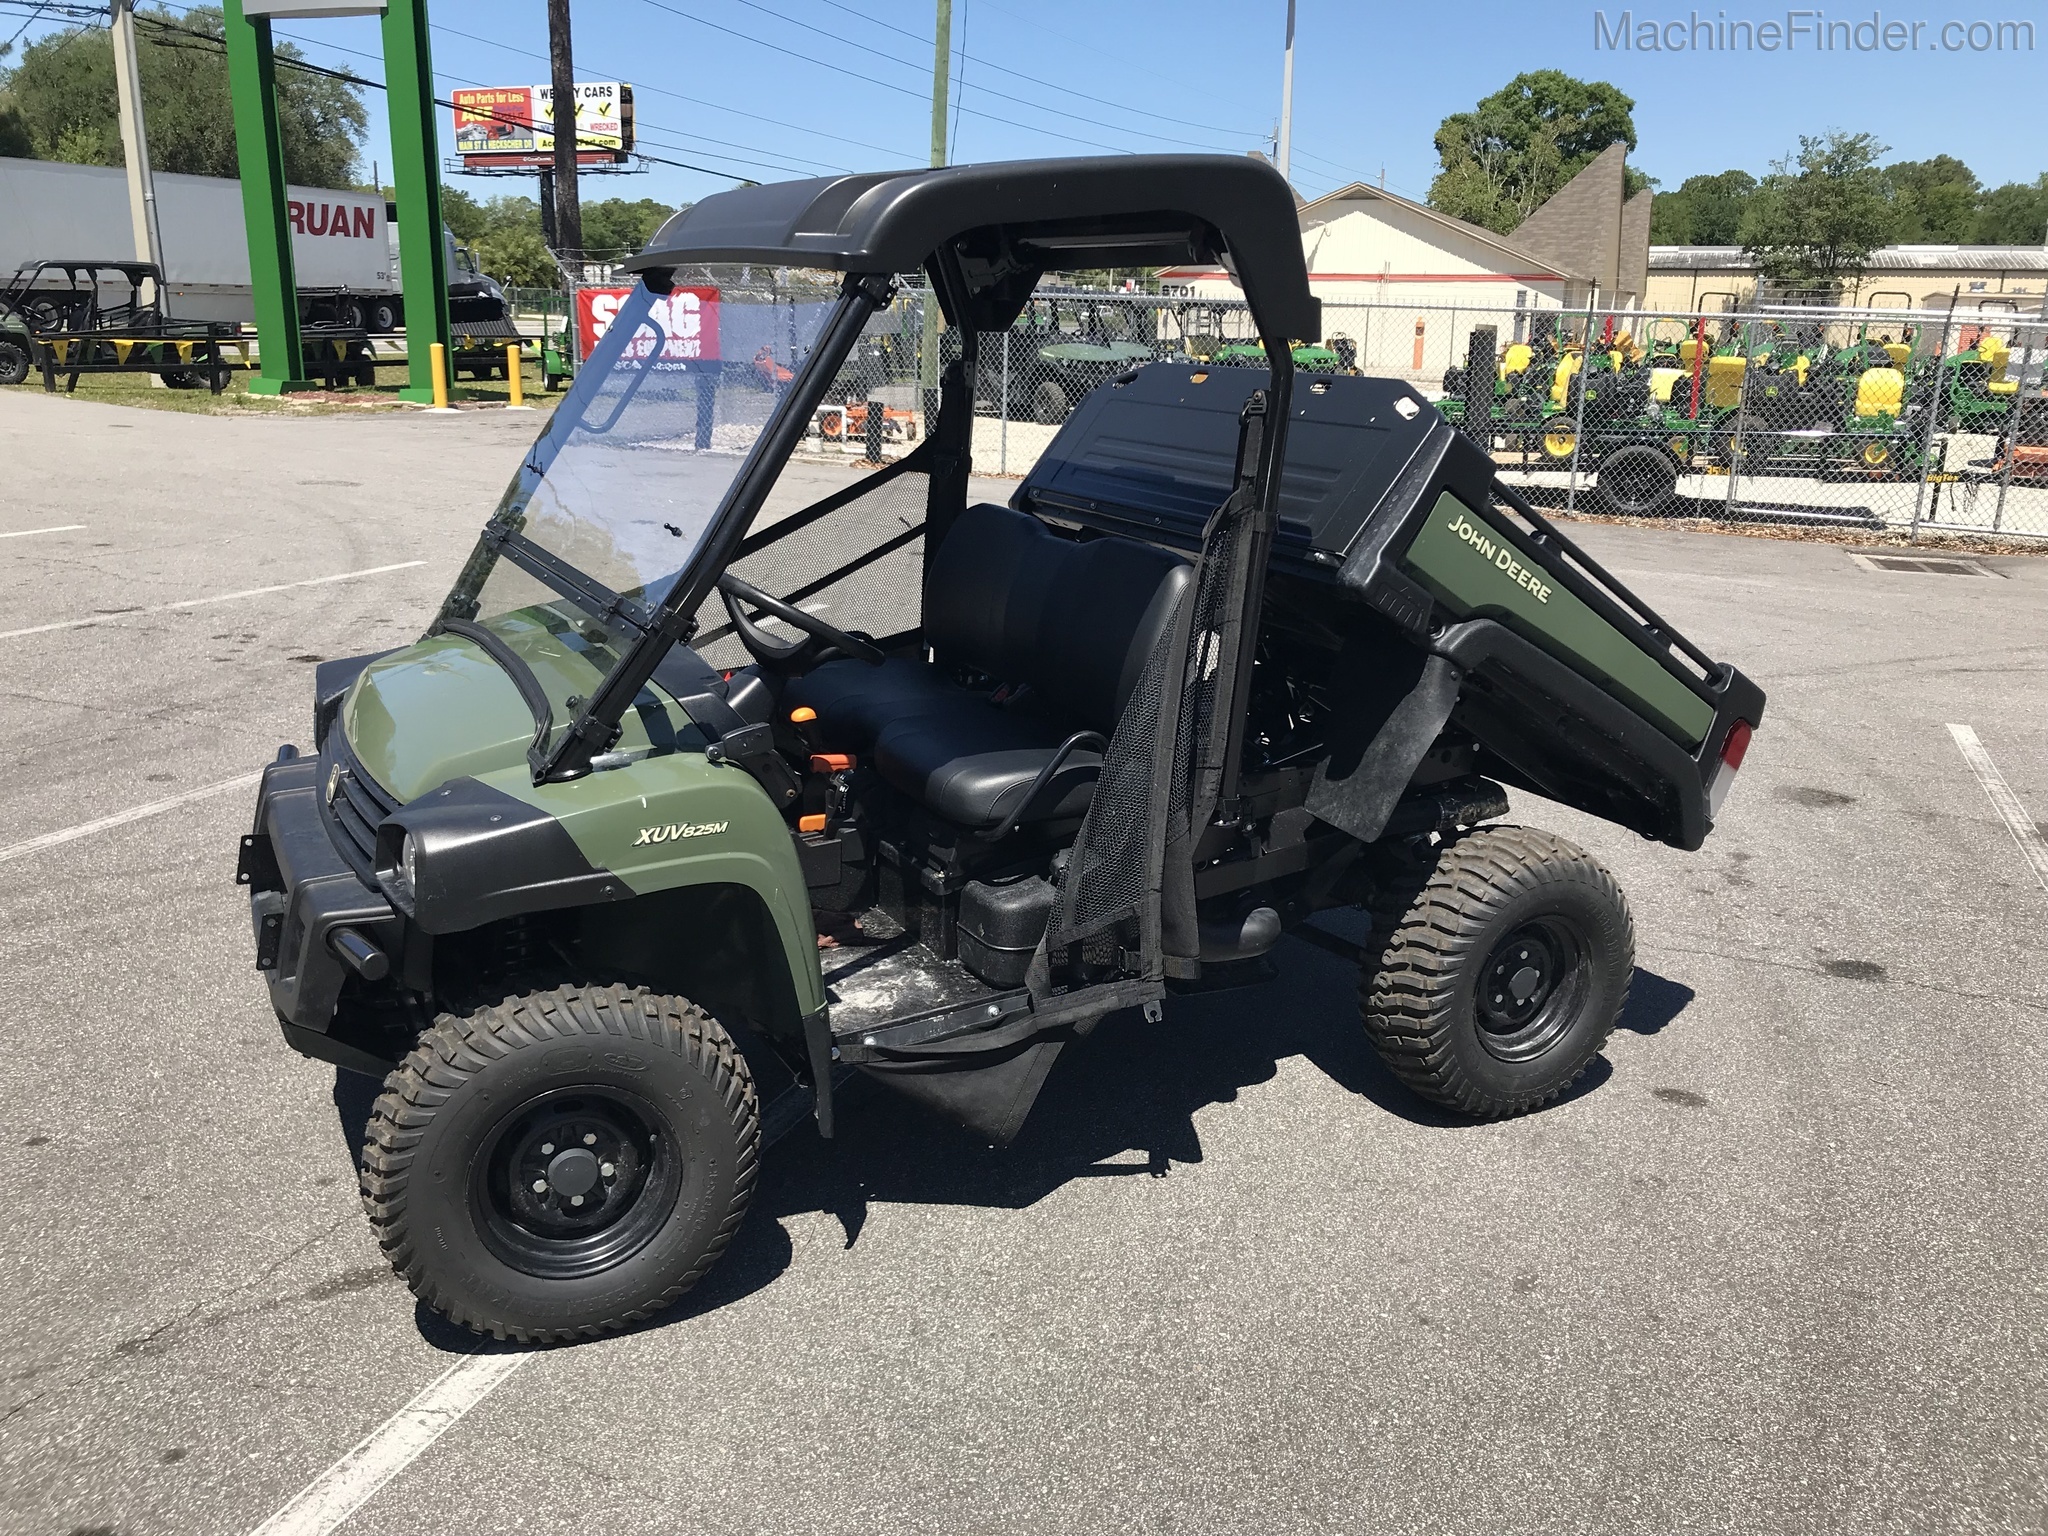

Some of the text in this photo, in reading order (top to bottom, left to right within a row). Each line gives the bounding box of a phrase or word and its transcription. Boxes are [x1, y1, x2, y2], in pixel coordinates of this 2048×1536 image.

[459, 91, 524, 105] Auto Parts for Less
[584, 86, 612, 98] CARS
[461, 106, 494, 121] ACE
[590, 122, 618, 131] WRECKED
[288, 200, 375, 239] RUAN
[1161, 284, 1195, 298] 8701
[1447, 514, 1552, 604] JOHN DEERE
[632, 821, 730, 847] XUV825M
